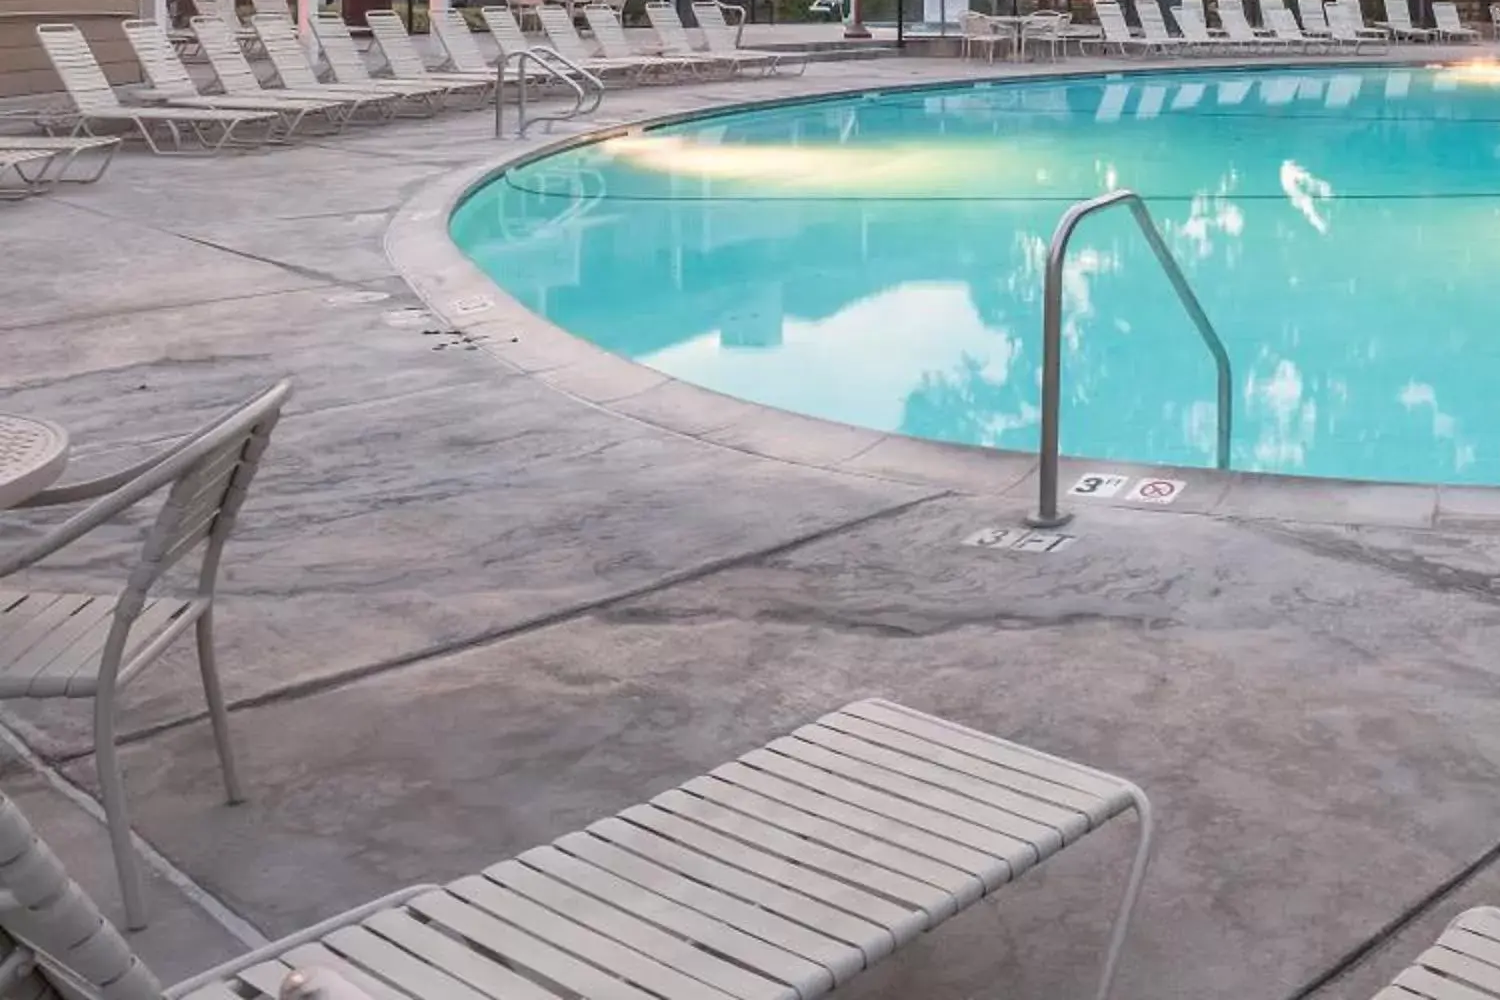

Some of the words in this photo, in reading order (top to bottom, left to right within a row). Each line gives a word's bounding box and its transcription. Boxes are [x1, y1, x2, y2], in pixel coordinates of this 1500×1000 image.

[1075, 477, 1103, 493] 3
[977, 529, 1009, 545] 3
[1014, 531, 1076, 552] FT
